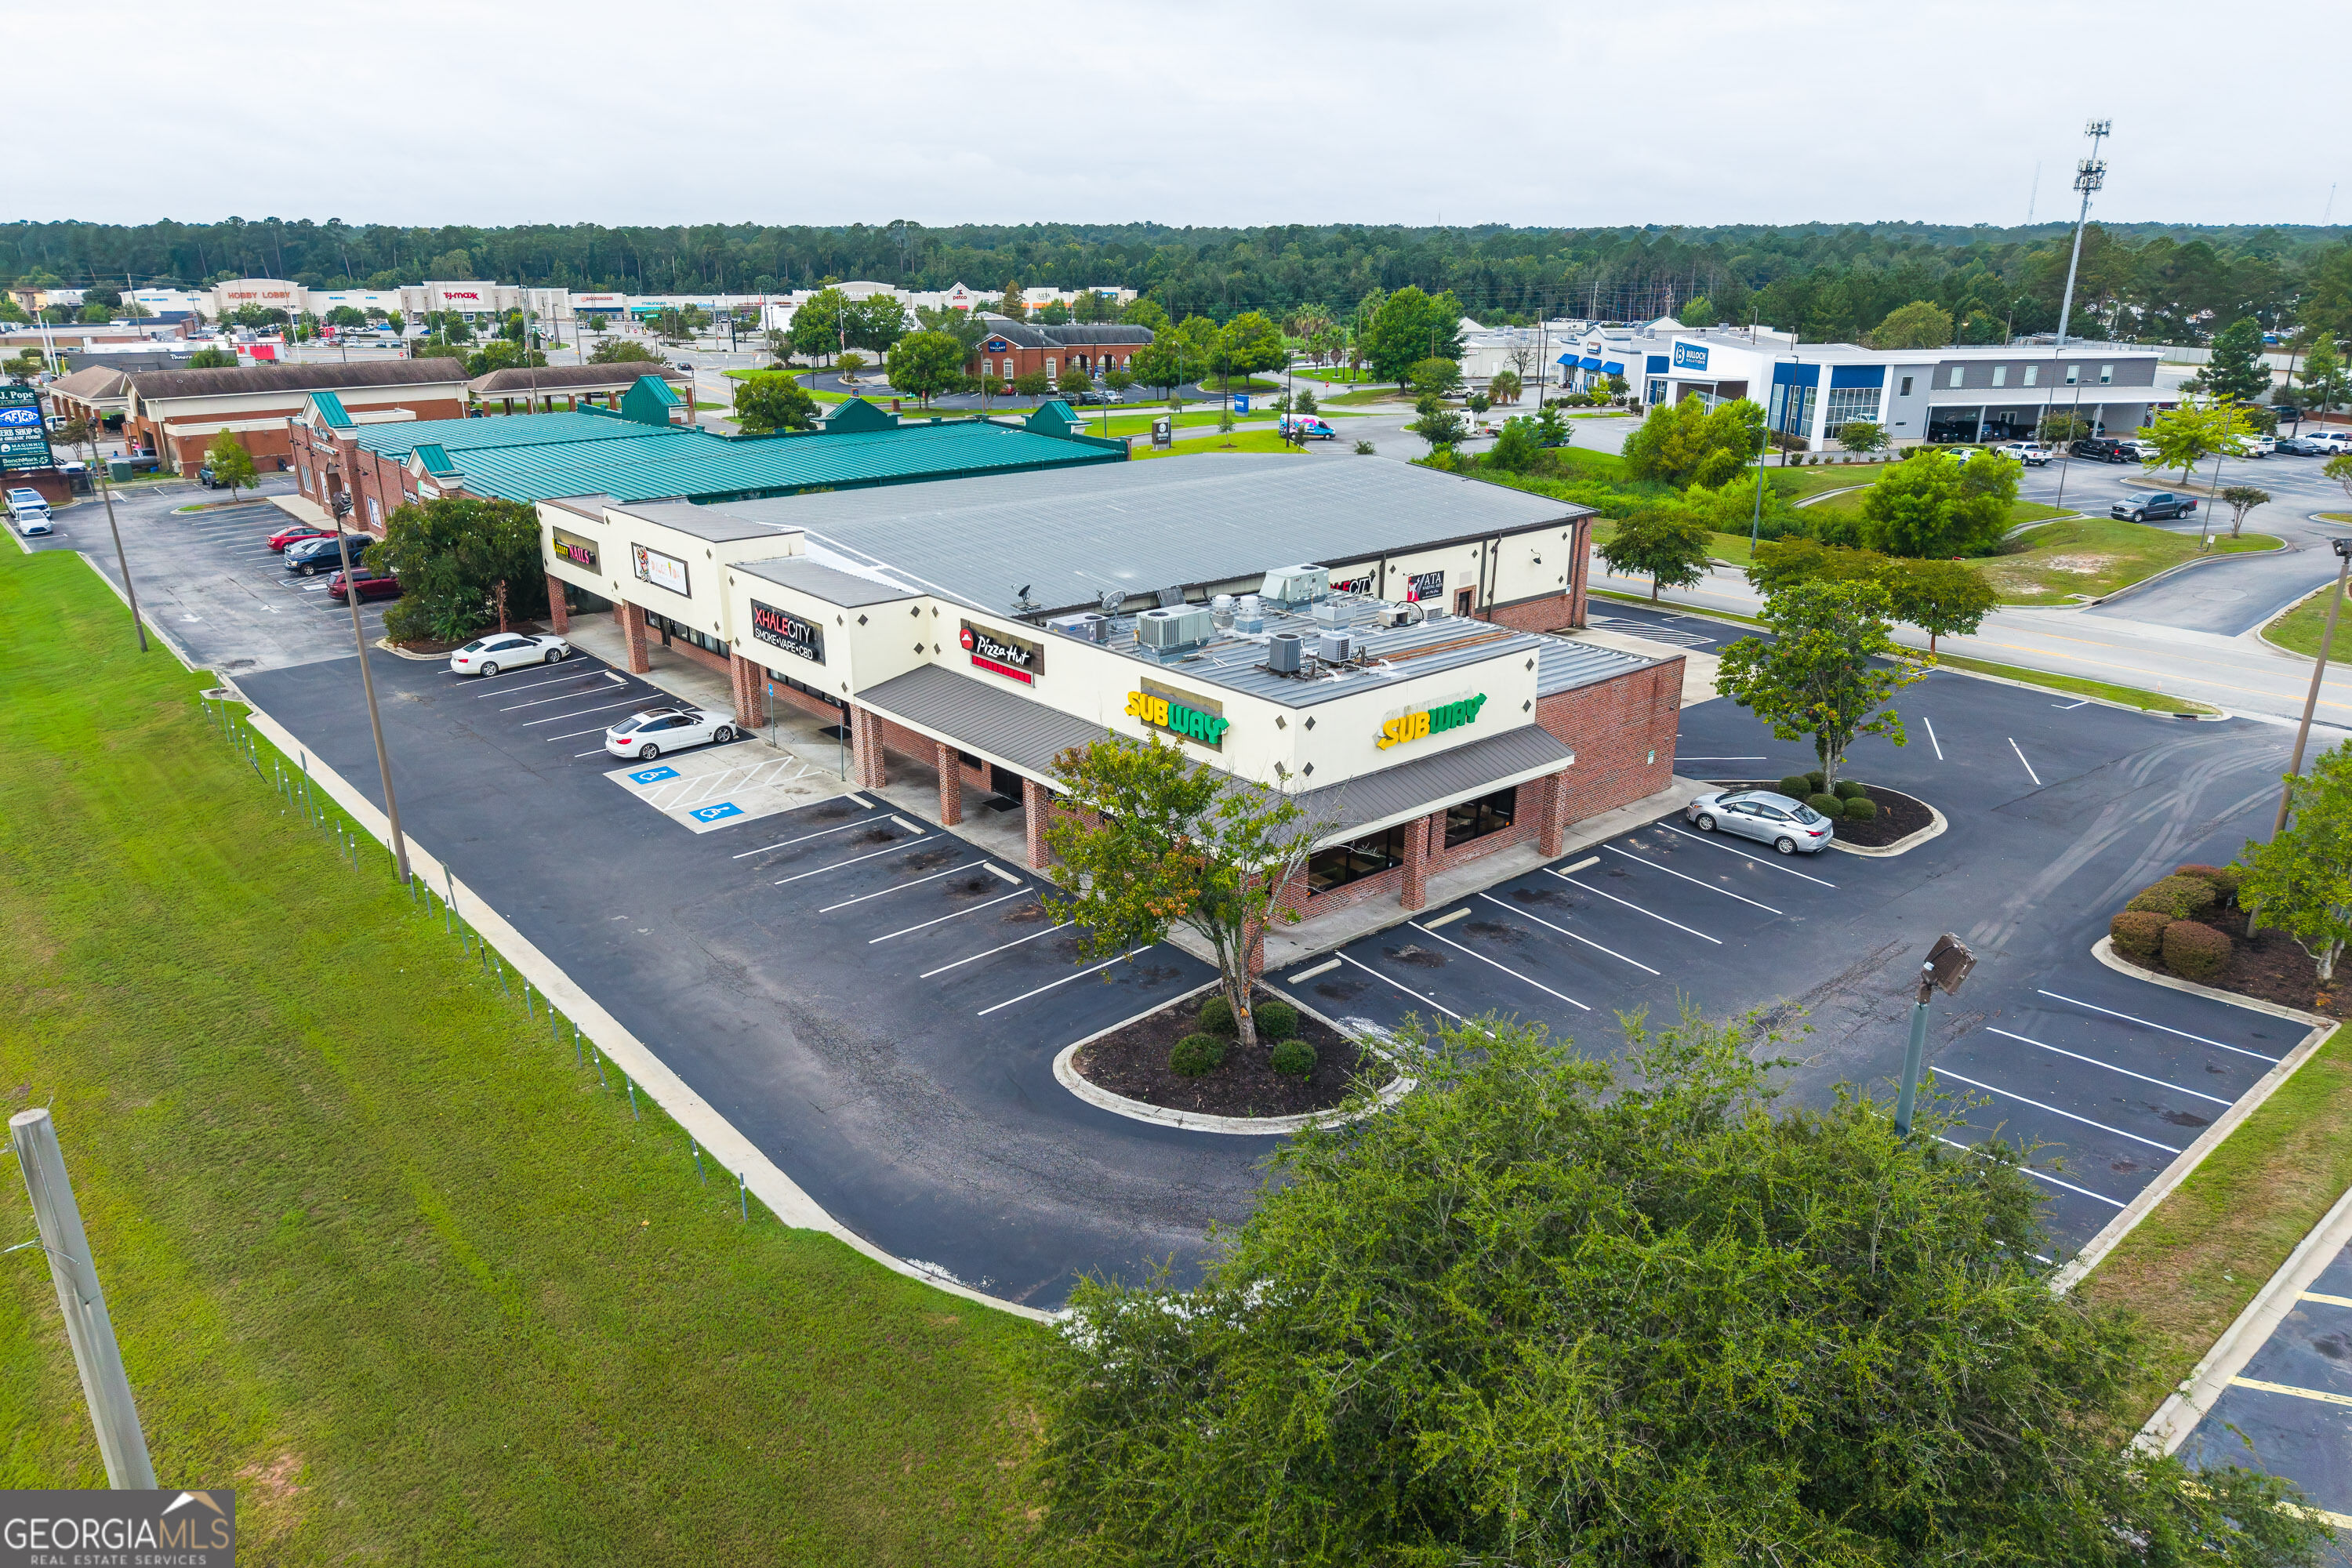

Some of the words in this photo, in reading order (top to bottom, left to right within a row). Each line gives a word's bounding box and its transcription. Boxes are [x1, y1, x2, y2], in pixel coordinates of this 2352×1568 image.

[1686, 350, 1707, 361] BULLOCH
[9, 390, 34, 401] Pope
[14, 427, 33, 436] SHOP
[552, 538, 568, 558] Luxury
[568, 543, 590, 564] NAILS
[1424, 572, 1442, 586] ATA
[976, 635, 1006, 659] Pizza
[1006, 644, 1030, 666] Hut
[1123, 691, 1230, 745] SUBWAY
[1377, 692, 1488, 751] SUBWAY
